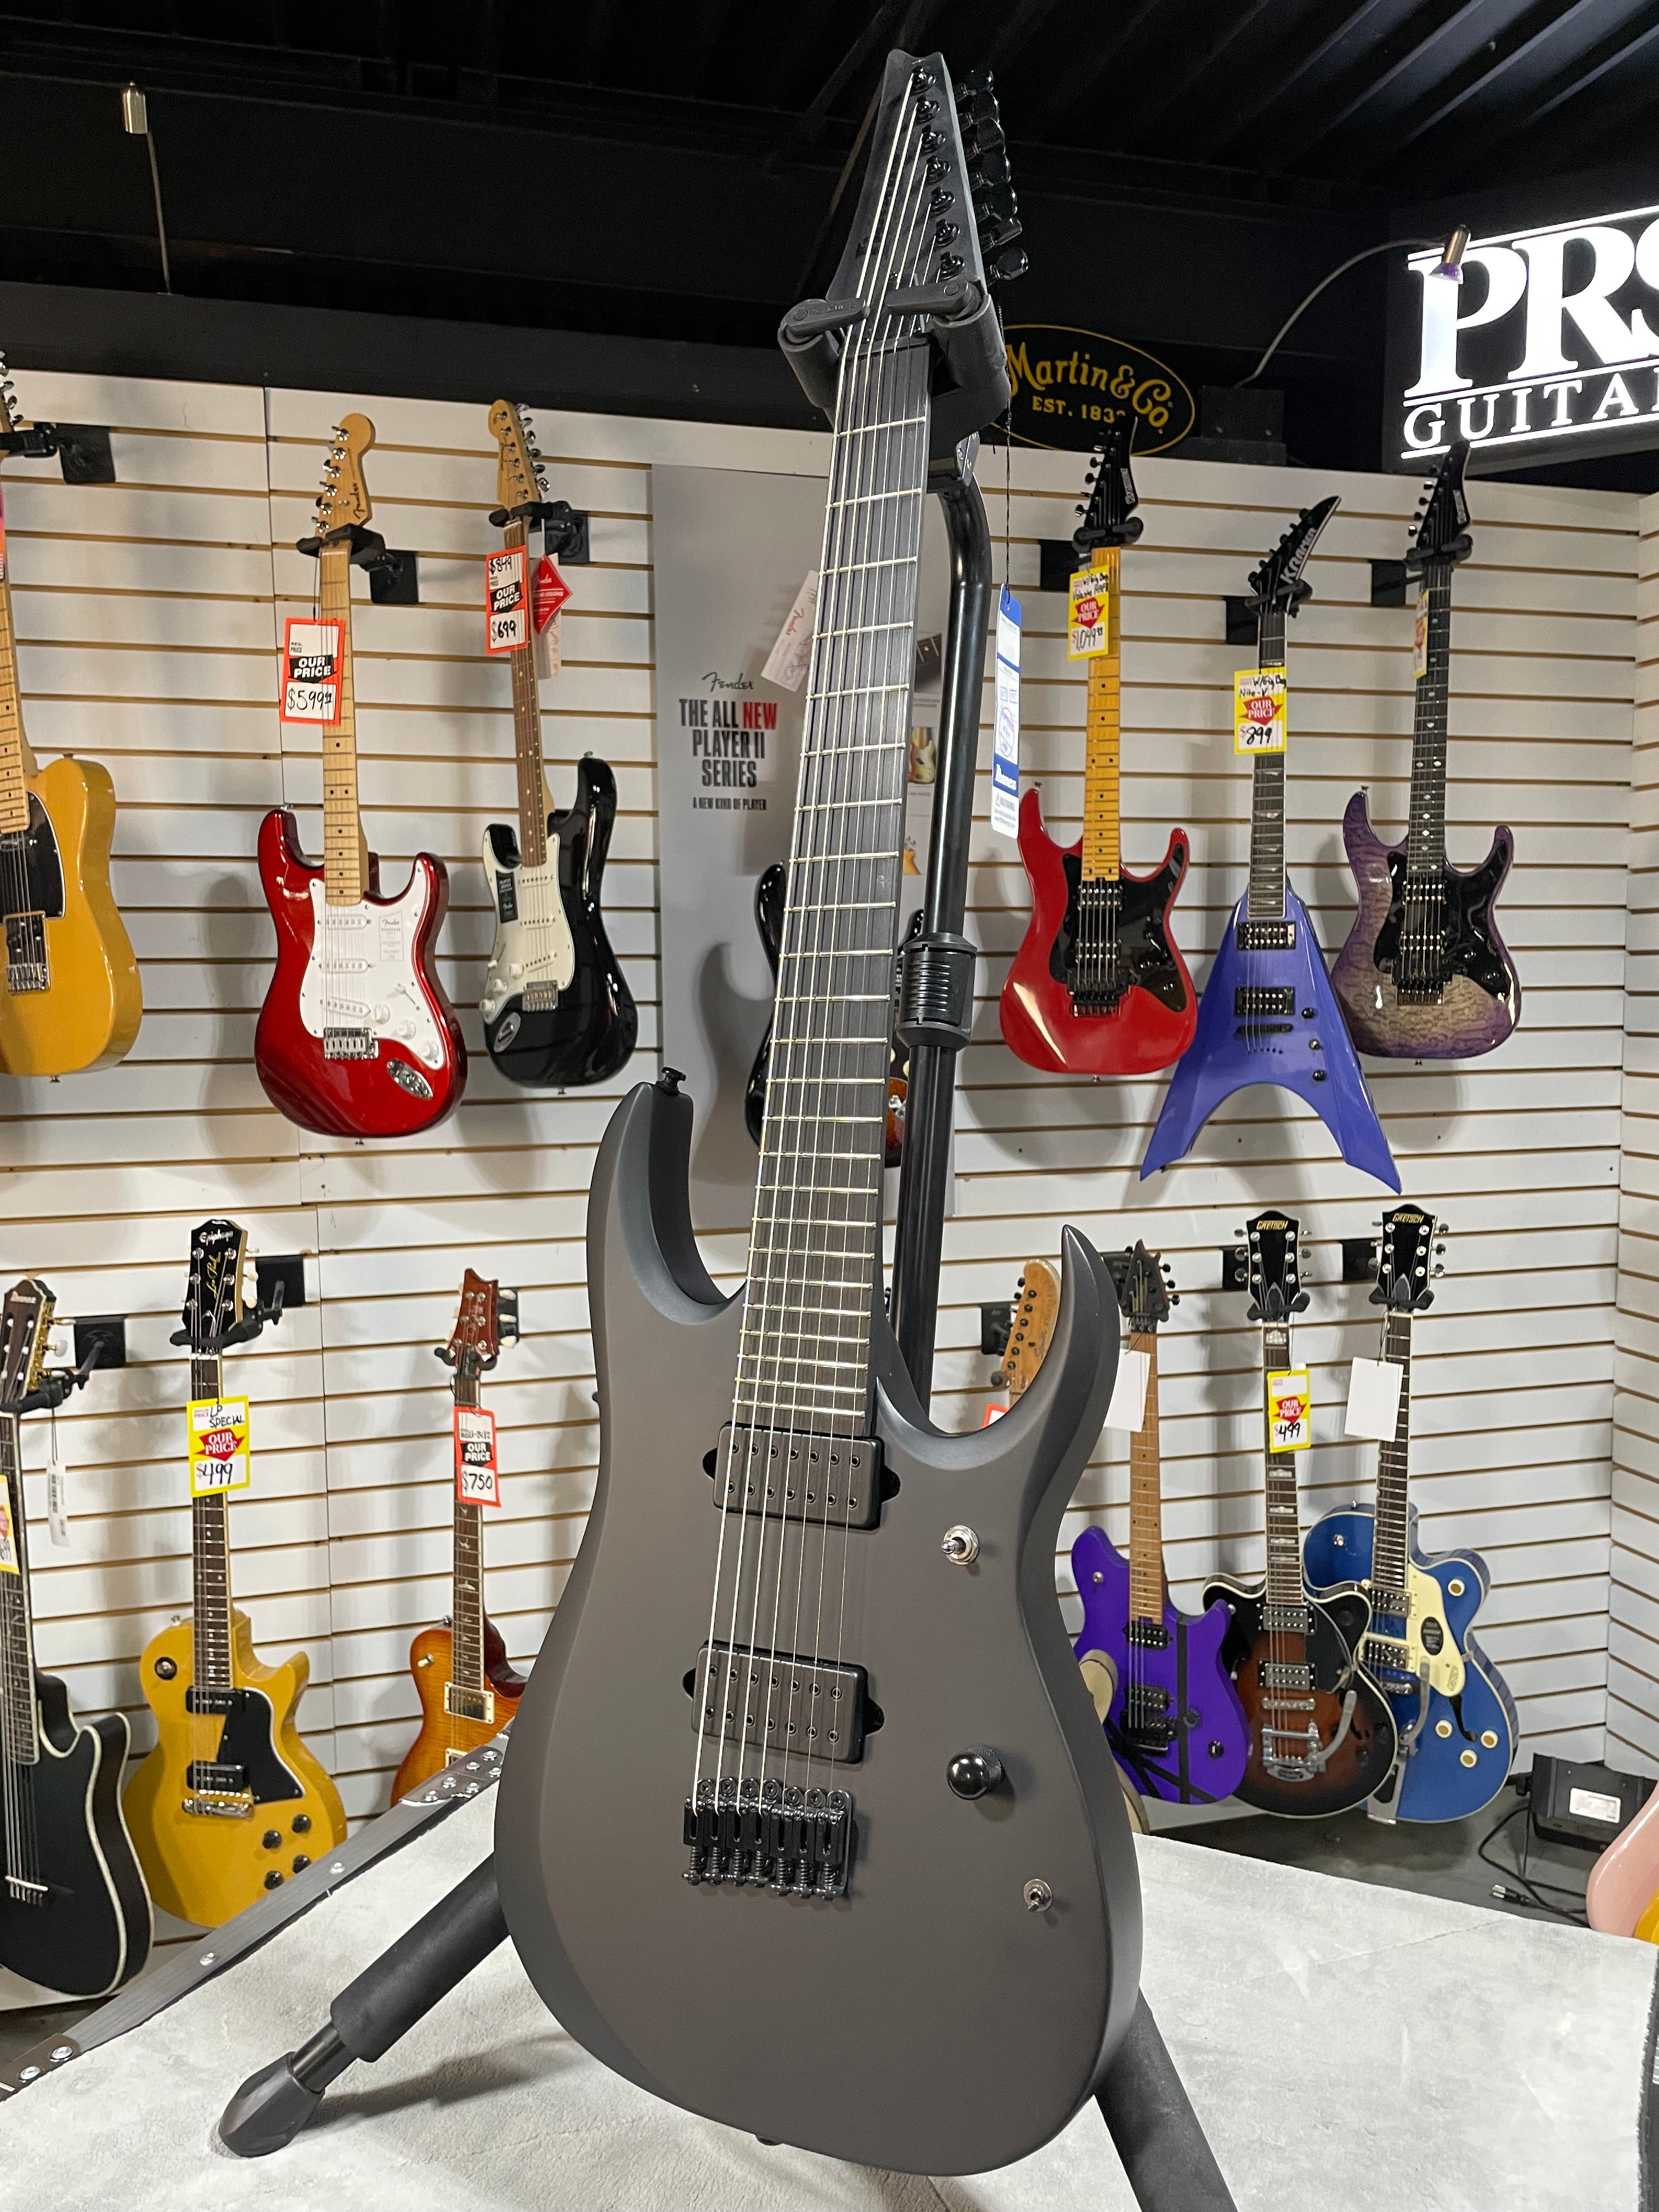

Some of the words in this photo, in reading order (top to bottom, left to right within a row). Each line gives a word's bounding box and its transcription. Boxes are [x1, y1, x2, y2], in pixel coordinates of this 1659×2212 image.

[1404, 366, 1659, 449] GUITA
[496, 585, 515, 600] OUR
[494, 591, 521, 611] PRICE
[1080, 601, 1097, 613] OUR
[298, 657, 325, 668] OUR
[294, 665, 331, 678] PRICE
[702, 672, 754, 692] Fender
[1251, 699, 1272, 710] OUR
[679, 699, 708, 727] THE
[713, 701, 738, 728] ALL
[743, 702, 777, 730] NEW
[1248, 708, 1275, 719] PRICE
[693, 730, 751, 758] PLAYER
[754, 732, 765, 759] II
[702, 759, 757, 787] SERIES
[693, 797, 697, 809] A
[699, 797, 713, 809] NEW
[743, 799, 766, 810] PLAYER
[1256, 1220, 1288, 1230] GRETSCH
[1282, 1400, 1299, 1409] OUR
[1280, 1407, 1301, 1418] PRICE
[208, 1432, 233, 1444] OUR
[205, 1441, 237, 1455] PRICE
[467, 1443, 486, 1452] OUR
[465, 1452, 491, 1462] PRICE
[462, 1471, 493, 1492] $750
